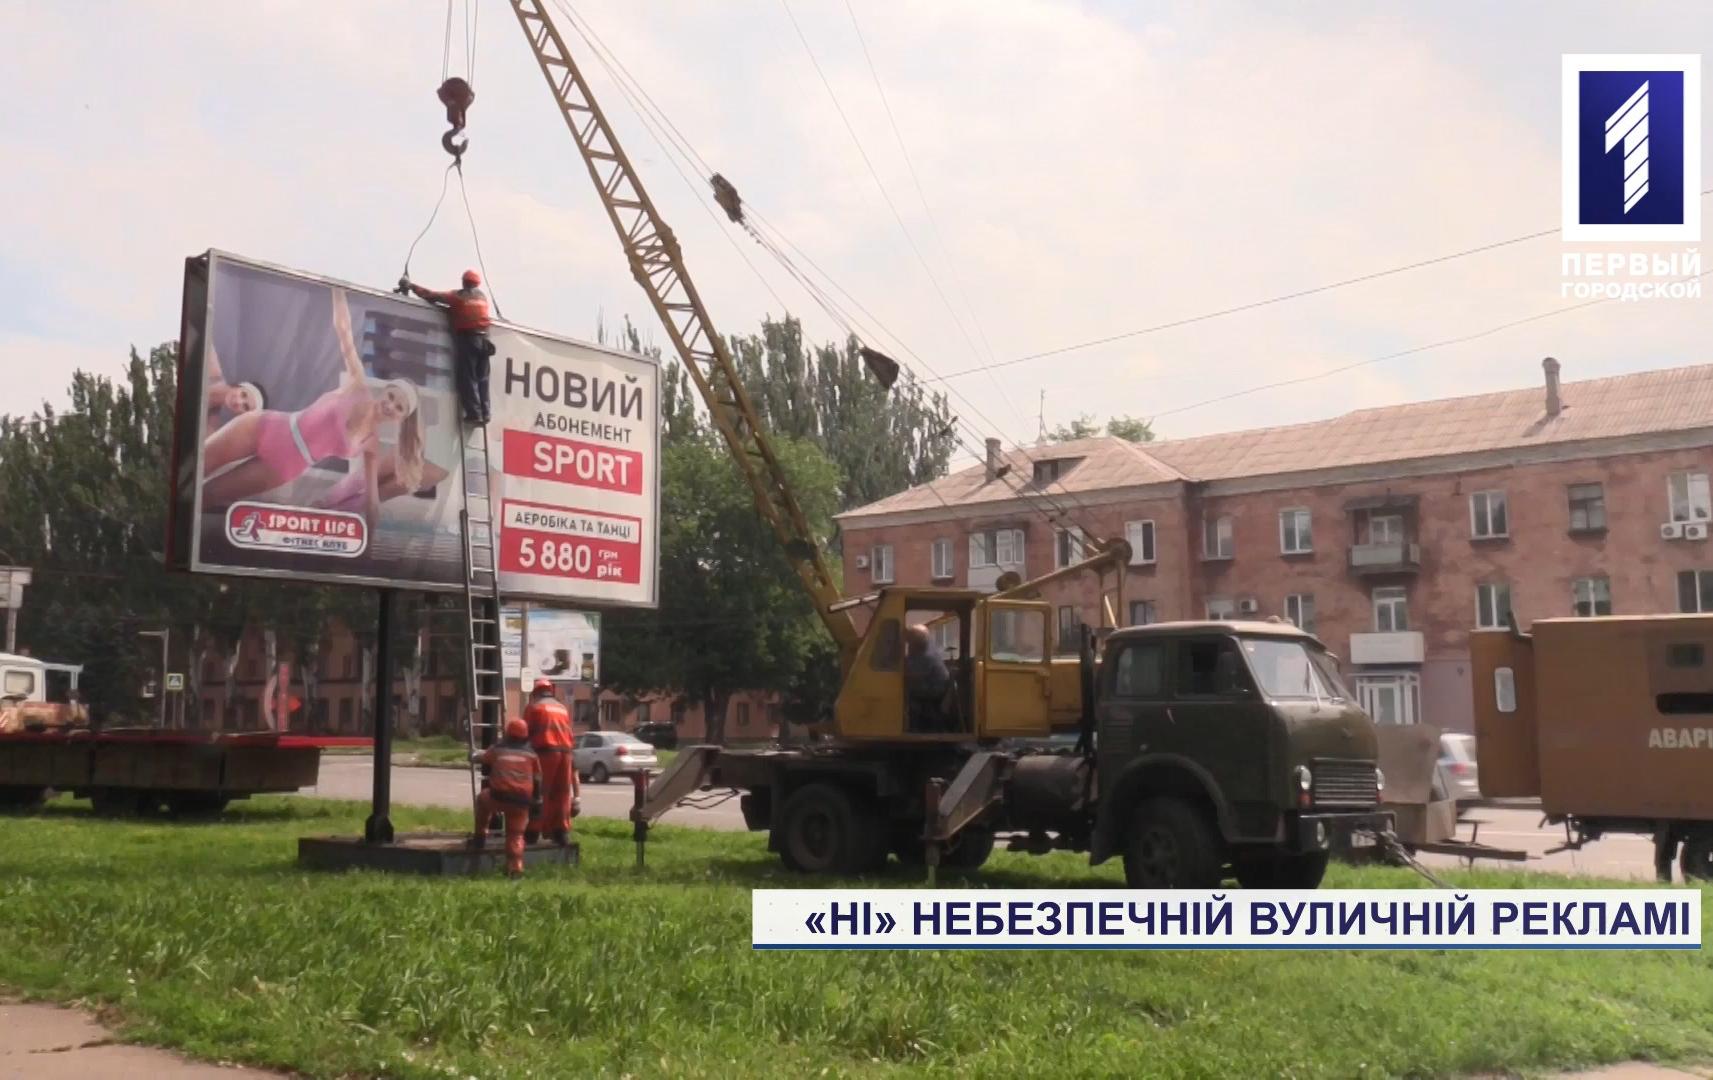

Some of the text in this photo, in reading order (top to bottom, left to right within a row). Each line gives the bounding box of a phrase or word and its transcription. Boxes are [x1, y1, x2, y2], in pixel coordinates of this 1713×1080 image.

[505, 357, 642, 421] НОВИЙ
[535, 411, 632, 443] АБОНЕМЕНТ
[534, 441, 633, 486] SPORT
[269, 514, 356, 536] SPORT LIFE
[514, 511, 631, 539] АЕРОБІКА ТА ТАНЦІ
[598, 549, 618, 560] грн
[597, 563, 622, 578] рік
